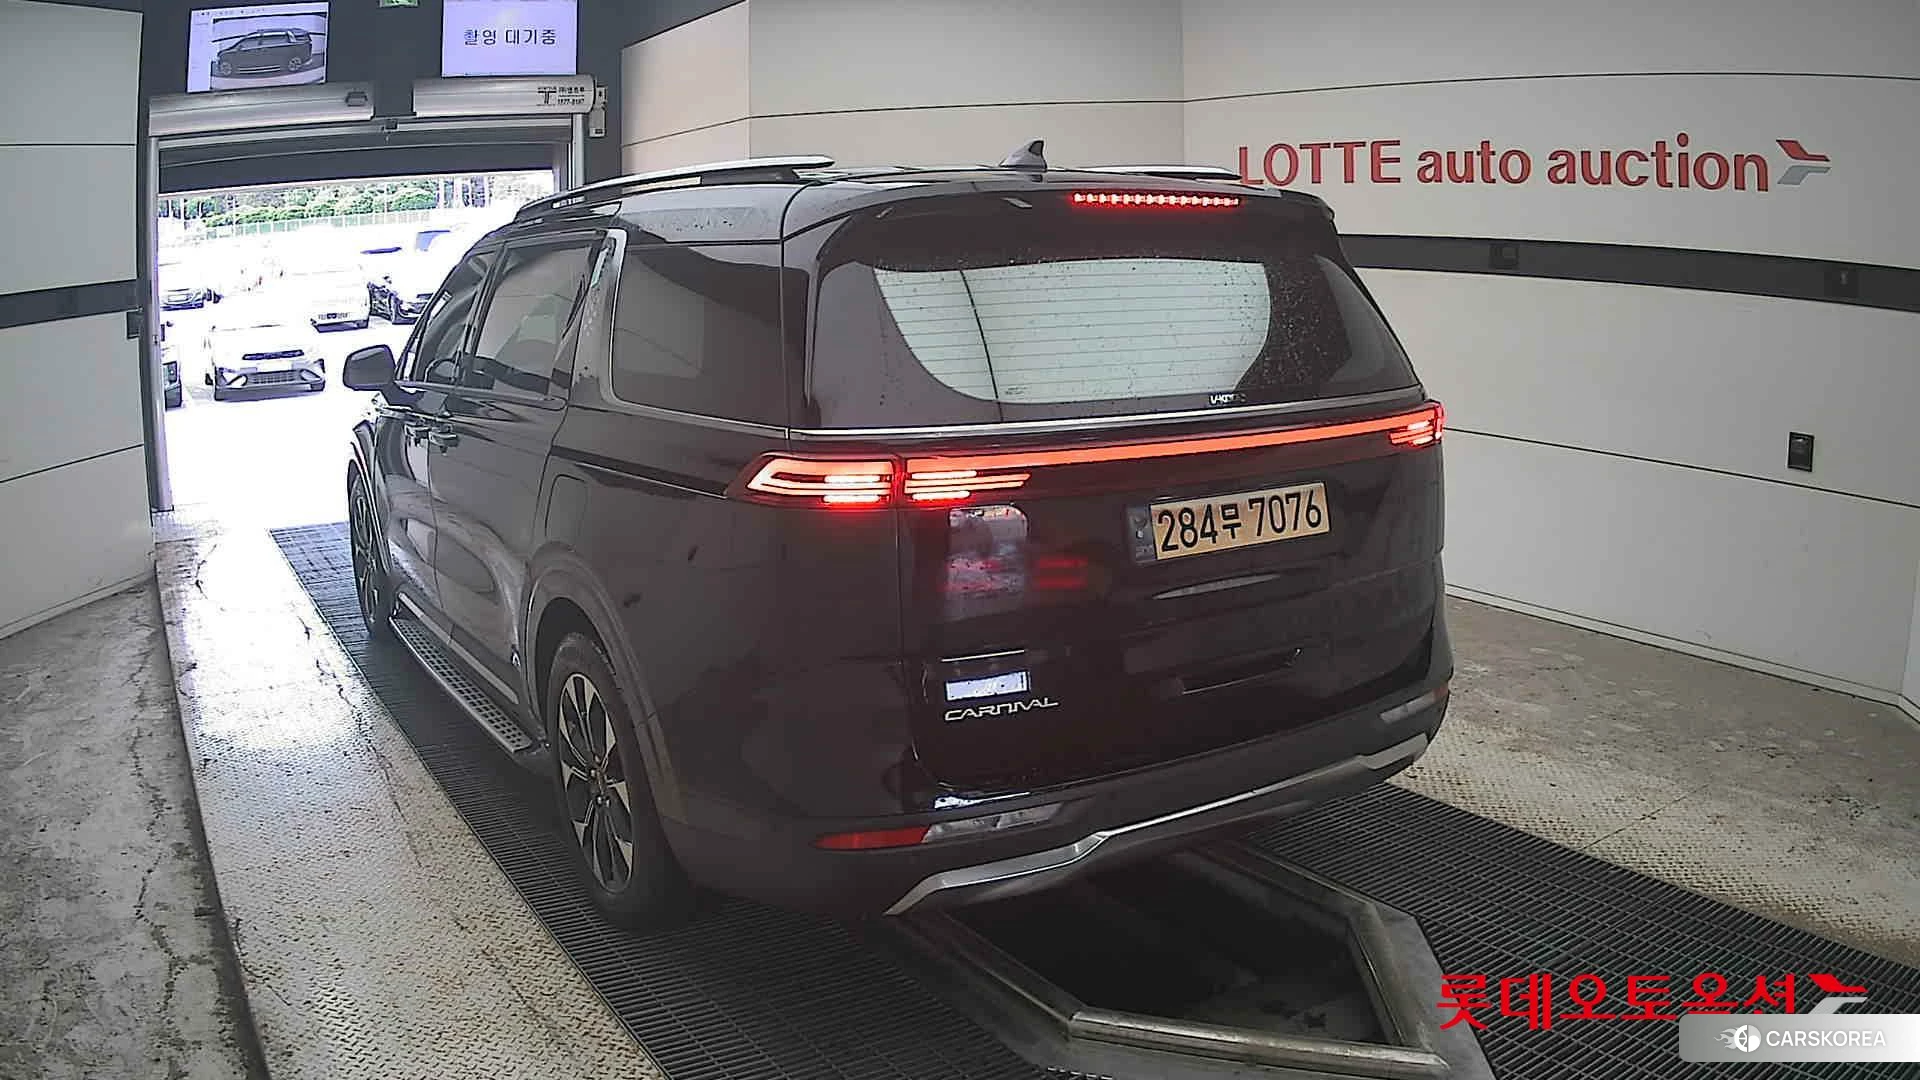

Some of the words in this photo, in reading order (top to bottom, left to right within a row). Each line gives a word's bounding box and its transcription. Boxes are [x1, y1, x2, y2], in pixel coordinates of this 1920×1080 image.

[505, 29, 557, 46] 대기중
[1239, 140, 1401, 187] LOTTE
[1417, 139, 1532, 184] auto
[1547, 132, 1769, 192] auction
[1158, 503, 1242, 552] 284무
[1248, 490, 1322, 537] 7076
[944, 697, 1059, 721] CARNIVAL
